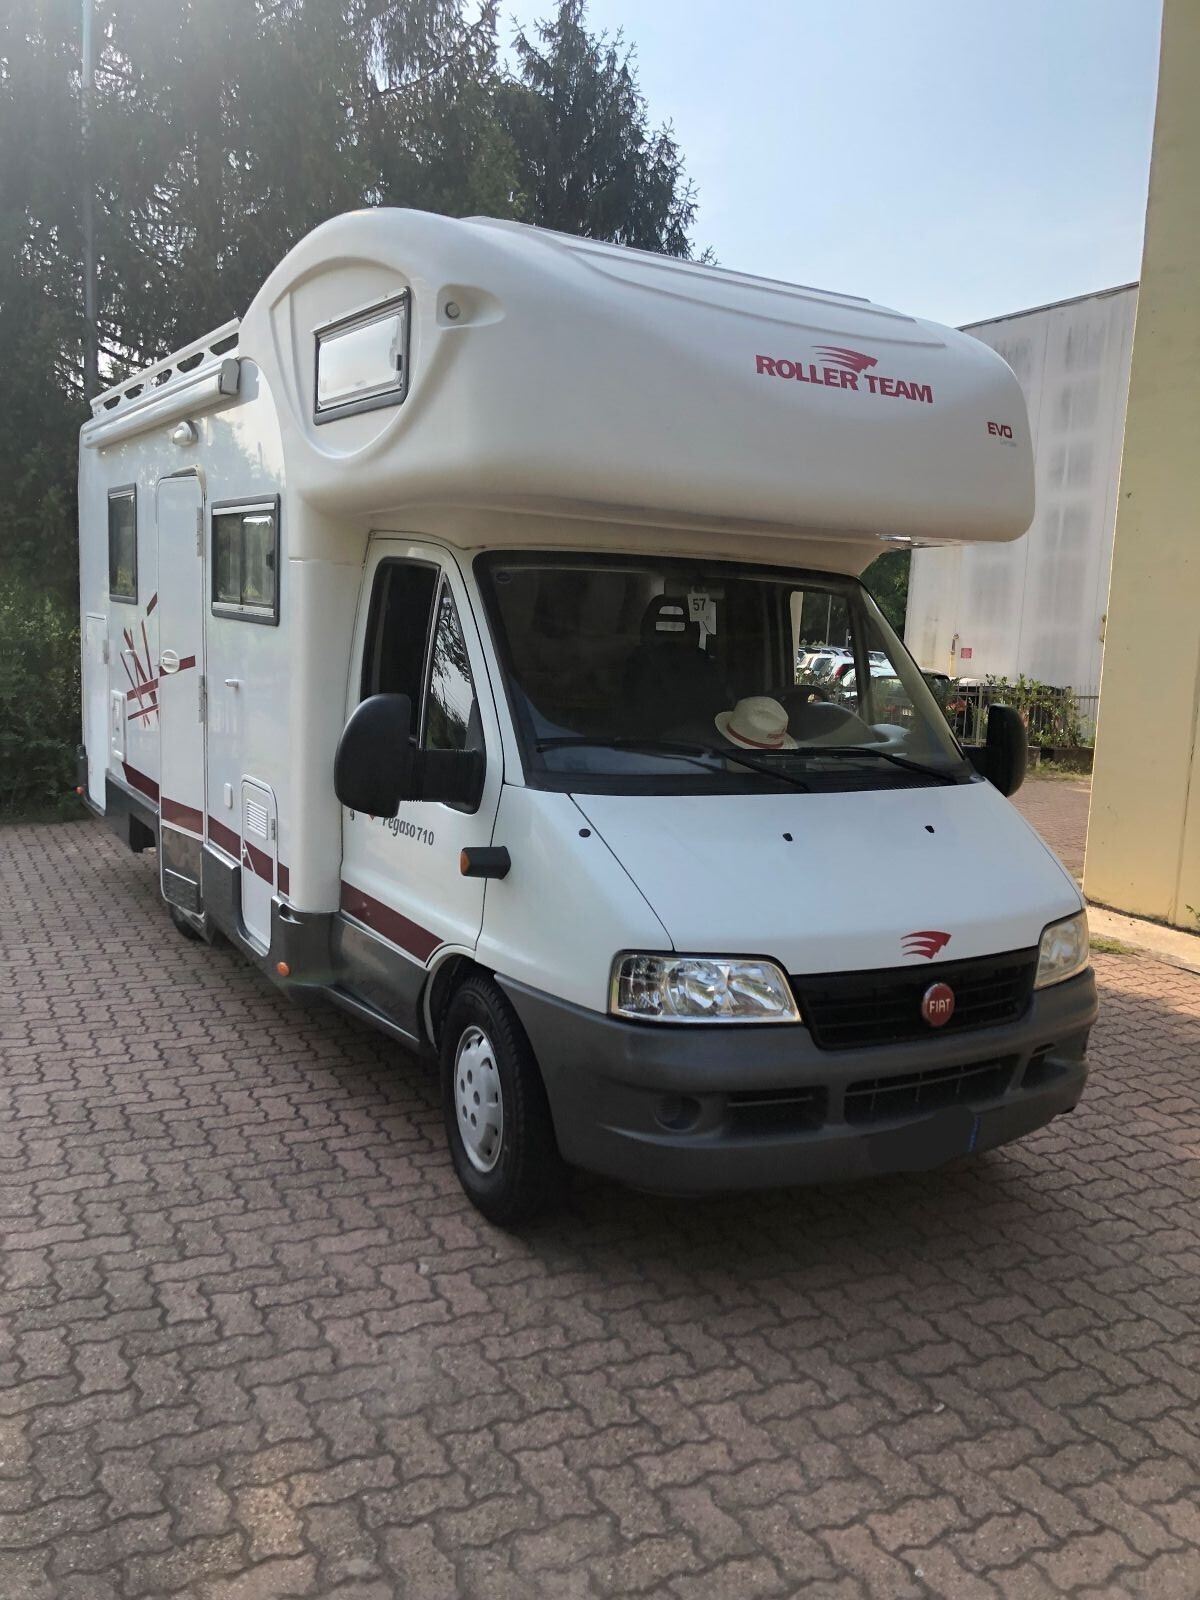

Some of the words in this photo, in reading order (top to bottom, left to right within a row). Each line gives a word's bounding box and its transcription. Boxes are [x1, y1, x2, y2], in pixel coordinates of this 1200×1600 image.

[755, 354, 859, 391] ROLLER
[864, 374, 933, 404] TEAM
[987, 421, 1013, 439] EVO
[692, 598, 706, 611] 57
[929, 998, 951, 1014] FIAT
